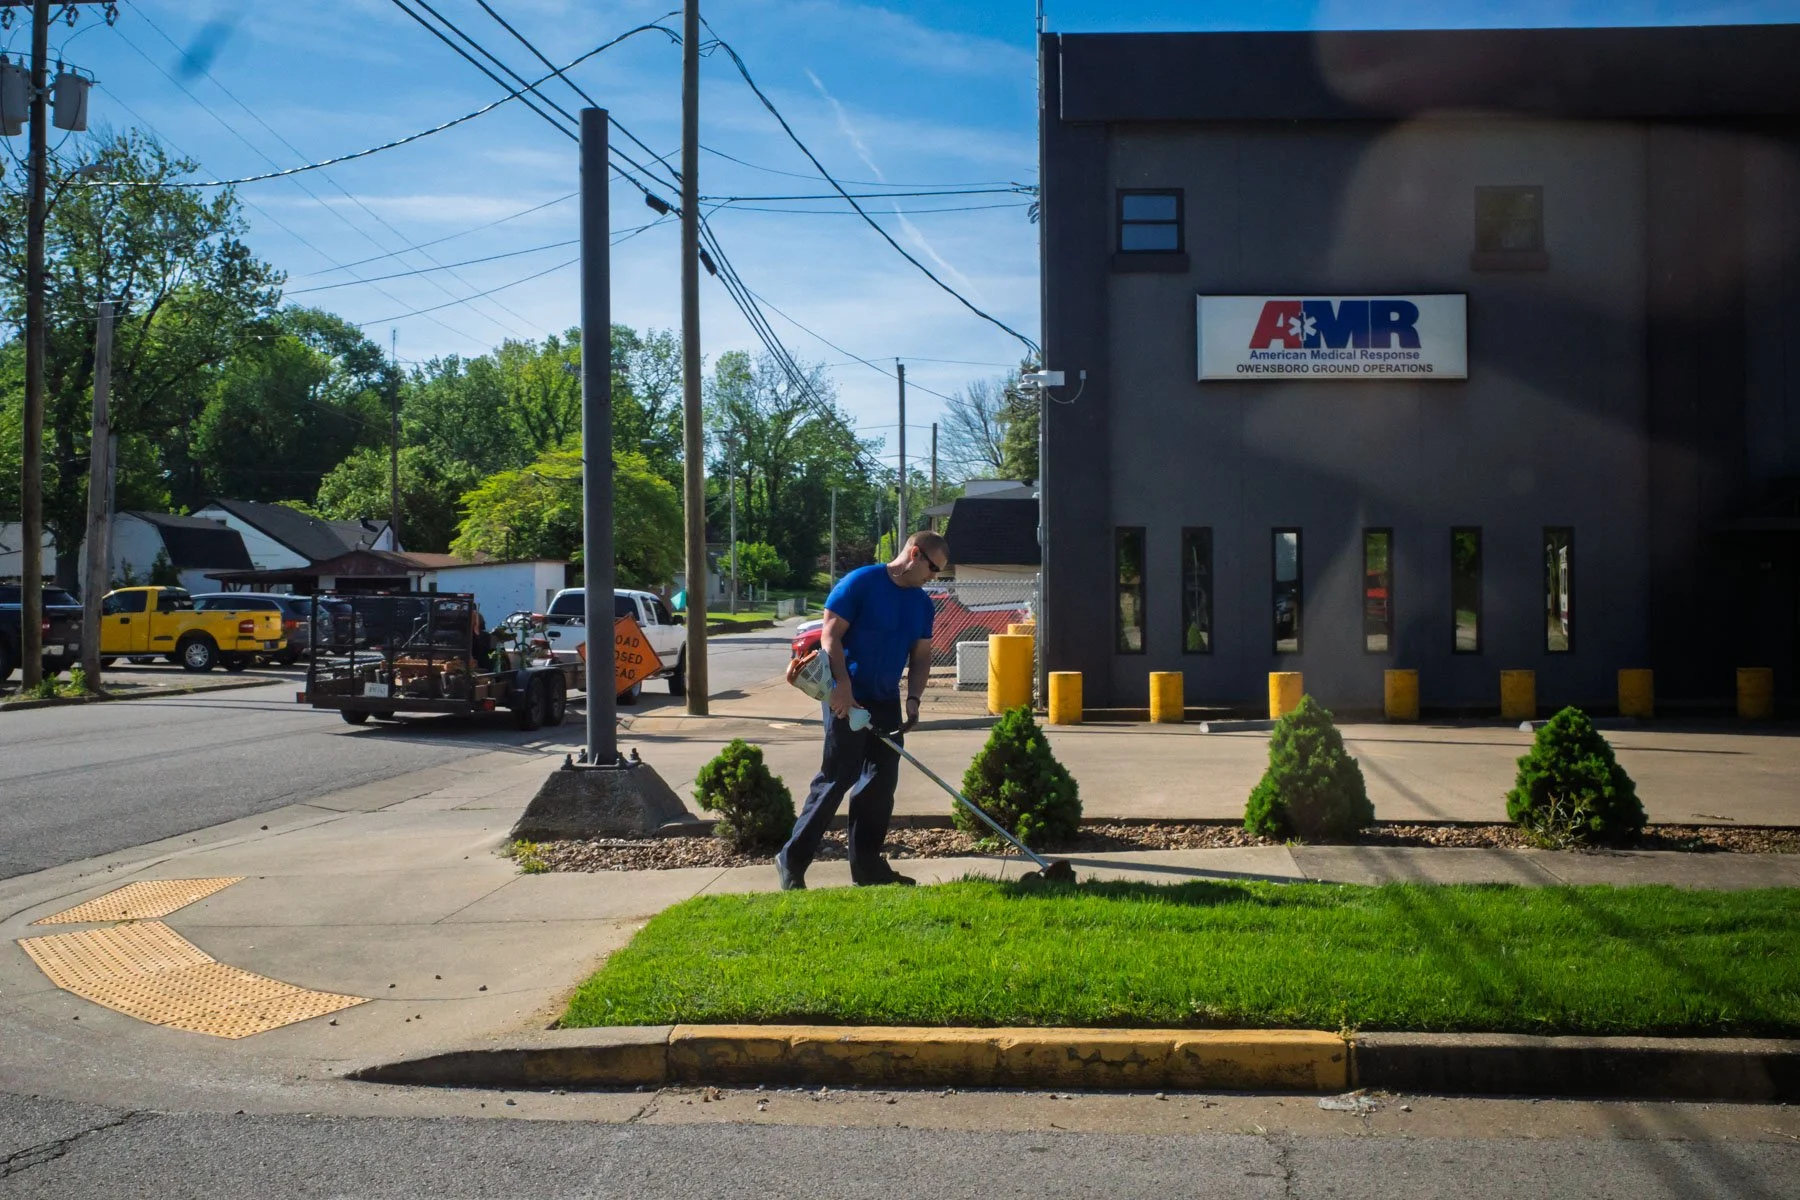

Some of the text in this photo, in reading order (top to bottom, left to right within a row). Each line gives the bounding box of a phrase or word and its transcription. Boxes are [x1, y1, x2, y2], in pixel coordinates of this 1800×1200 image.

[1249, 300, 1422, 349] AMR
[1249, 349, 1420, 362] American Medical Response
[1236, 363, 1433, 373] OWENSBORO GROUND OPERATIONS
[616, 635, 640, 648] OAD
[615, 650, 643, 665] OSED
[615, 667, 635, 680] EAD
